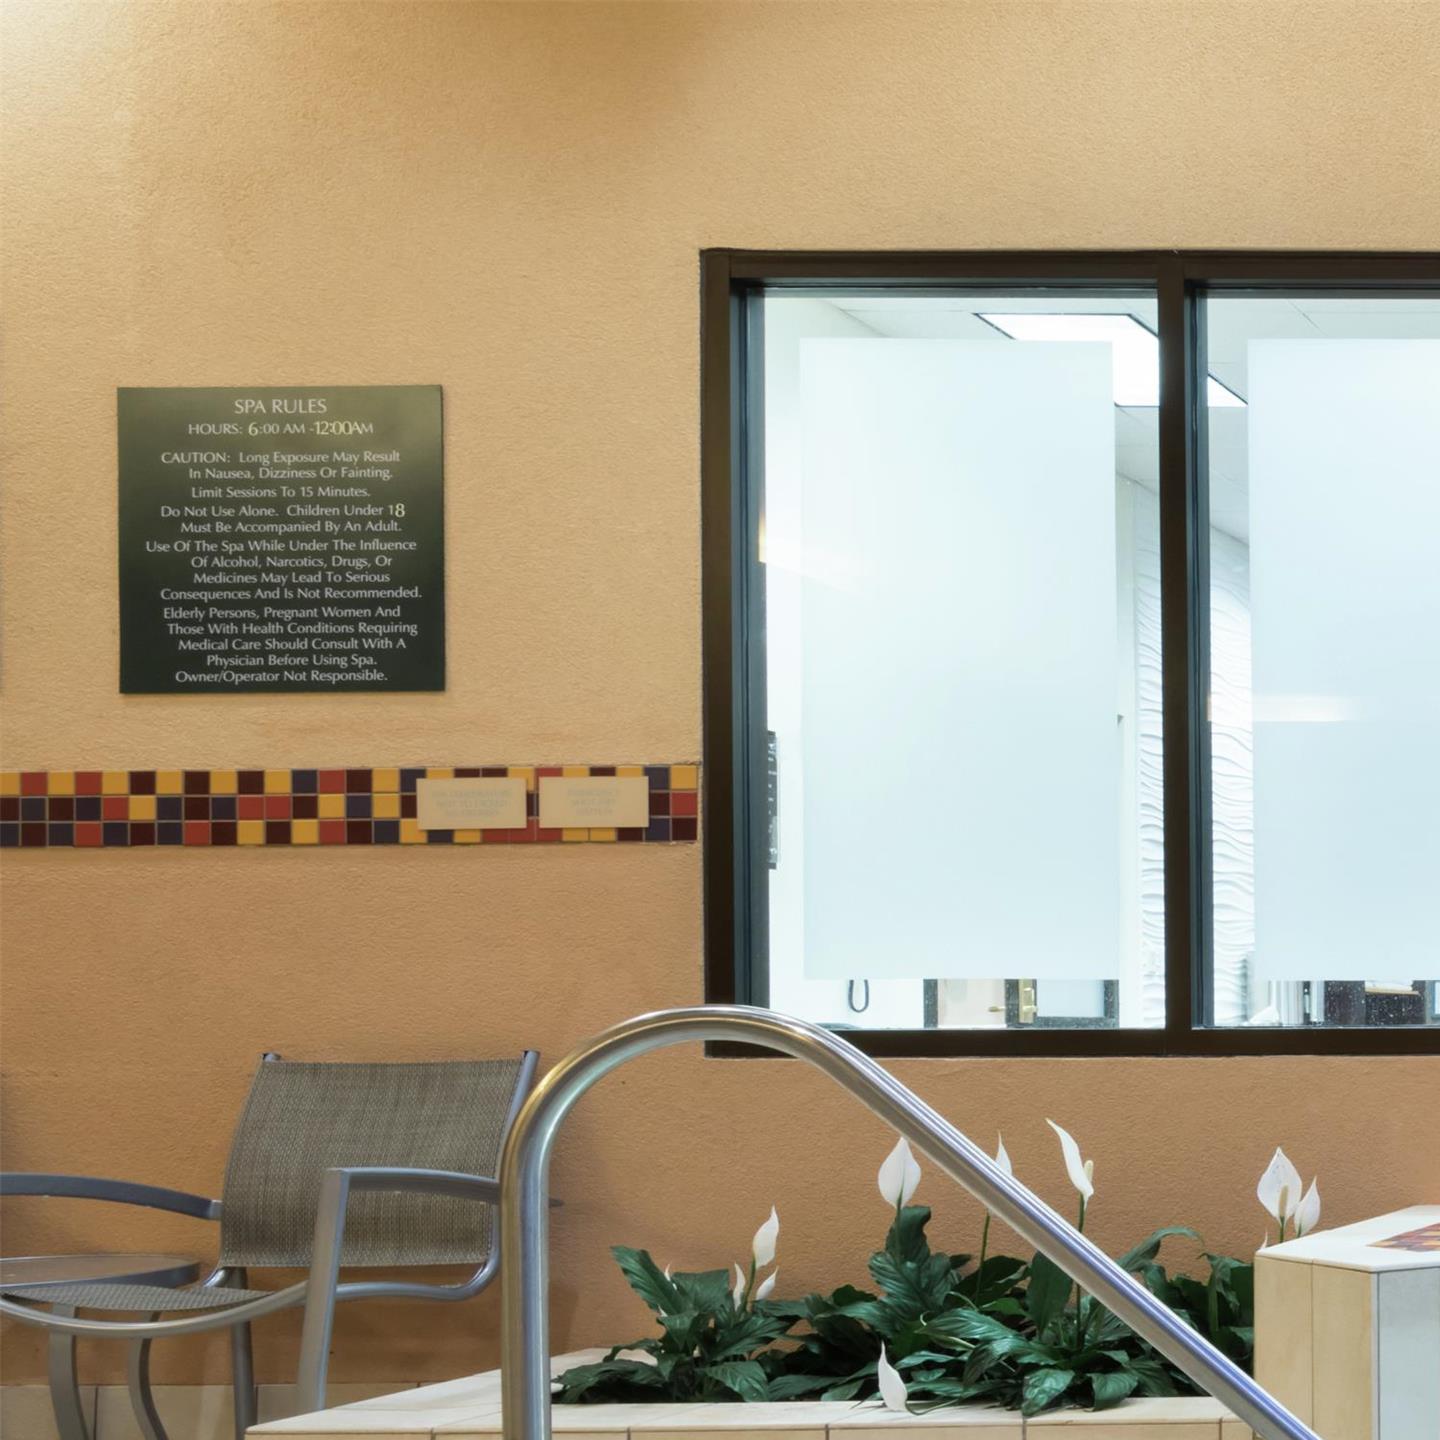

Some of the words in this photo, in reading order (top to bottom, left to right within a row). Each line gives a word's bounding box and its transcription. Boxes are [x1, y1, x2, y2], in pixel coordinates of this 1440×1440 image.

[235, 399, 266, 414] SPA
[272, 399, 327, 413] RULES
[189, 424, 242, 435] HOURS:
[248, 422, 279, 436] 6:00
[283, 424, 305, 434] AM
[161, 452, 230, 463] CAUTION:
[240, 452, 270, 466] Long
[273, 452, 329, 466] Exposure
[333, 452, 359, 465] May
[364, 451, 400, 462] Result
[189, 468, 201, 478] In
[205, 468, 254, 479] Nausea,
[259, 467, 317, 478] Dizziness
[320, 467, 337, 478] Or
[341, 467, 393, 481] Fainting.
[192, 487, 222, 498] Limit
[226, 487, 277, 497] Sessions
[280, 486, 296, 497] To
[300, 486, 313, 497] 15
[318, 486, 370, 497] Minutes.
[161, 506, 180, 517] Do
[184, 507, 207, 516] Not
[212, 506, 235, 517] Use
[239, 505, 278, 516] Alone.
[287, 504, 340, 516] Children
[344, 504, 384, 516] Under
[389, 504, 405, 517] 18
[181, 522, 211, 532] Must
[216, 521, 232, 532] Be
[235, 521, 320, 535] Accompanied
[325, 521, 340, 535] By
[344, 521, 361, 531] An
[366, 521, 402, 531] Adult.
[146, 541, 170, 552] Use
[173, 540, 191, 552] Of
[194, 540, 218, 551] The
[222, 540, 244, 554] Spa
[248, 540, 285, 551] While
[290, 539, 328, 551] Under
[332, 539, 356, 550] The
[360, 539, 417, 550] Influence
[191, 556, 208, 568] Of
[211, 556, 261, 568] Alcohol,
[267, 556, 327, 568] Narcotics,
[332, 555, 371, 570] Drugs,
[375, 555, 392, 566] Or
[194, 572, 257, 583] Medicines
[261, 573, 288, 586] May
[292, 571, 321, 583] Lead
[326, 571, 342, 582] To
[346, 571, 390, 582] Serious
[160, 588, 251, 603] Consequences
[255, 587, 280, 599] And
[284, 588, 293, 599] Is
[298, 588, 320, 598] Not
[325, 587, 422, 598] Recommended.
[164, 607, 205, 621] Elderly
[209, 607, 259, 619] Persons,
[264, 607, 318, 621] Pregnant
[322, 607, 371, 617] Women
[375, 607, 400, 617] And
[167, 623, 204, 634] Those
[208, 623, 238, 634] With
[243, 622, 283, 634] Health
[288, 622, 354, 633] Conditions
[359, 622, 418, 636] Requiring
[178, 639, 228, 650] Medical
[232, 639, 261, 650] Care
[265, 638, 308, 649] Should
[312, 638, 358, 649] Consult
[362, 638, 392, 649] With
[396, 638, 406, 648] A
[207, 654, 264, 668] Physician
[269, 654, 309, 665] Before
[313, 654, 348, 668] Using
[352, 654, 377, 668] Spa.
[175, 671, 280, 684] Owner/Operator
[284, 671, 306, 681] Not
[311, 670, 387, 684] Responsible.
